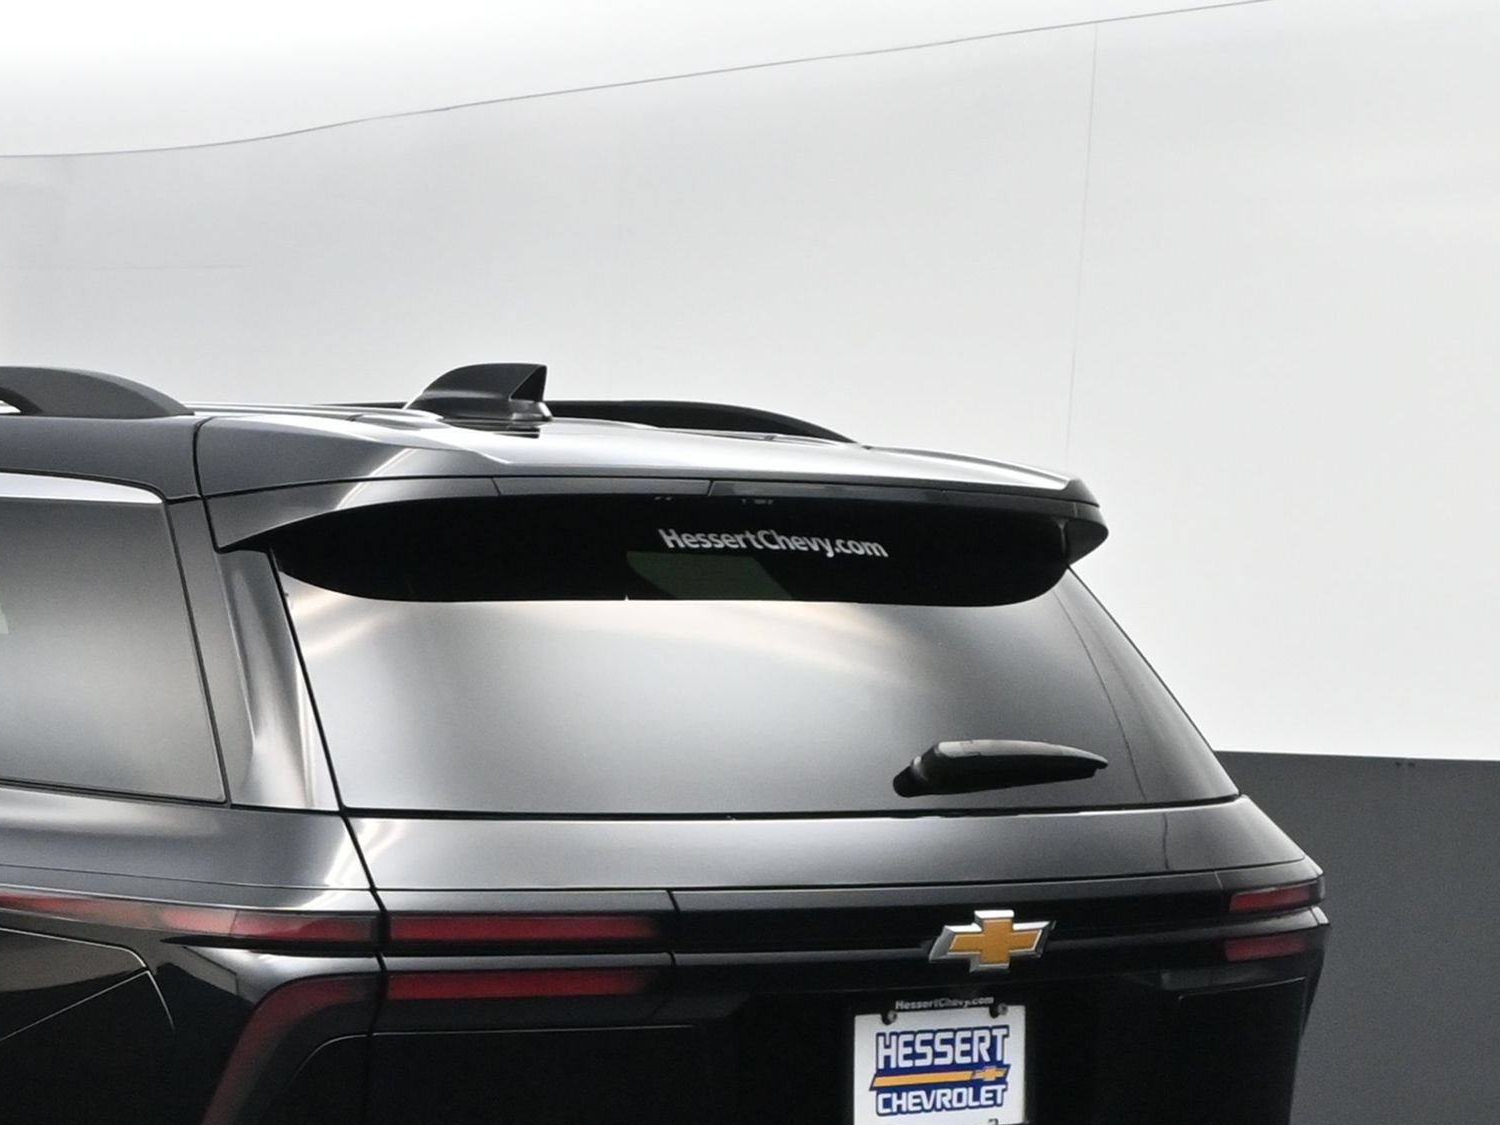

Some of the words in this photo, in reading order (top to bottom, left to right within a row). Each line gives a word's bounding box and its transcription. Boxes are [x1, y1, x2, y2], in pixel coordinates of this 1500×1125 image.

[658, 529, 889, 558] HessertChevy.com
[895, 997, 994, 1010] HessertChevy.com
[876, 1026, 1009, 1069] HESSERT
[876, 1084, 1008, 1116] CHEVROLET
